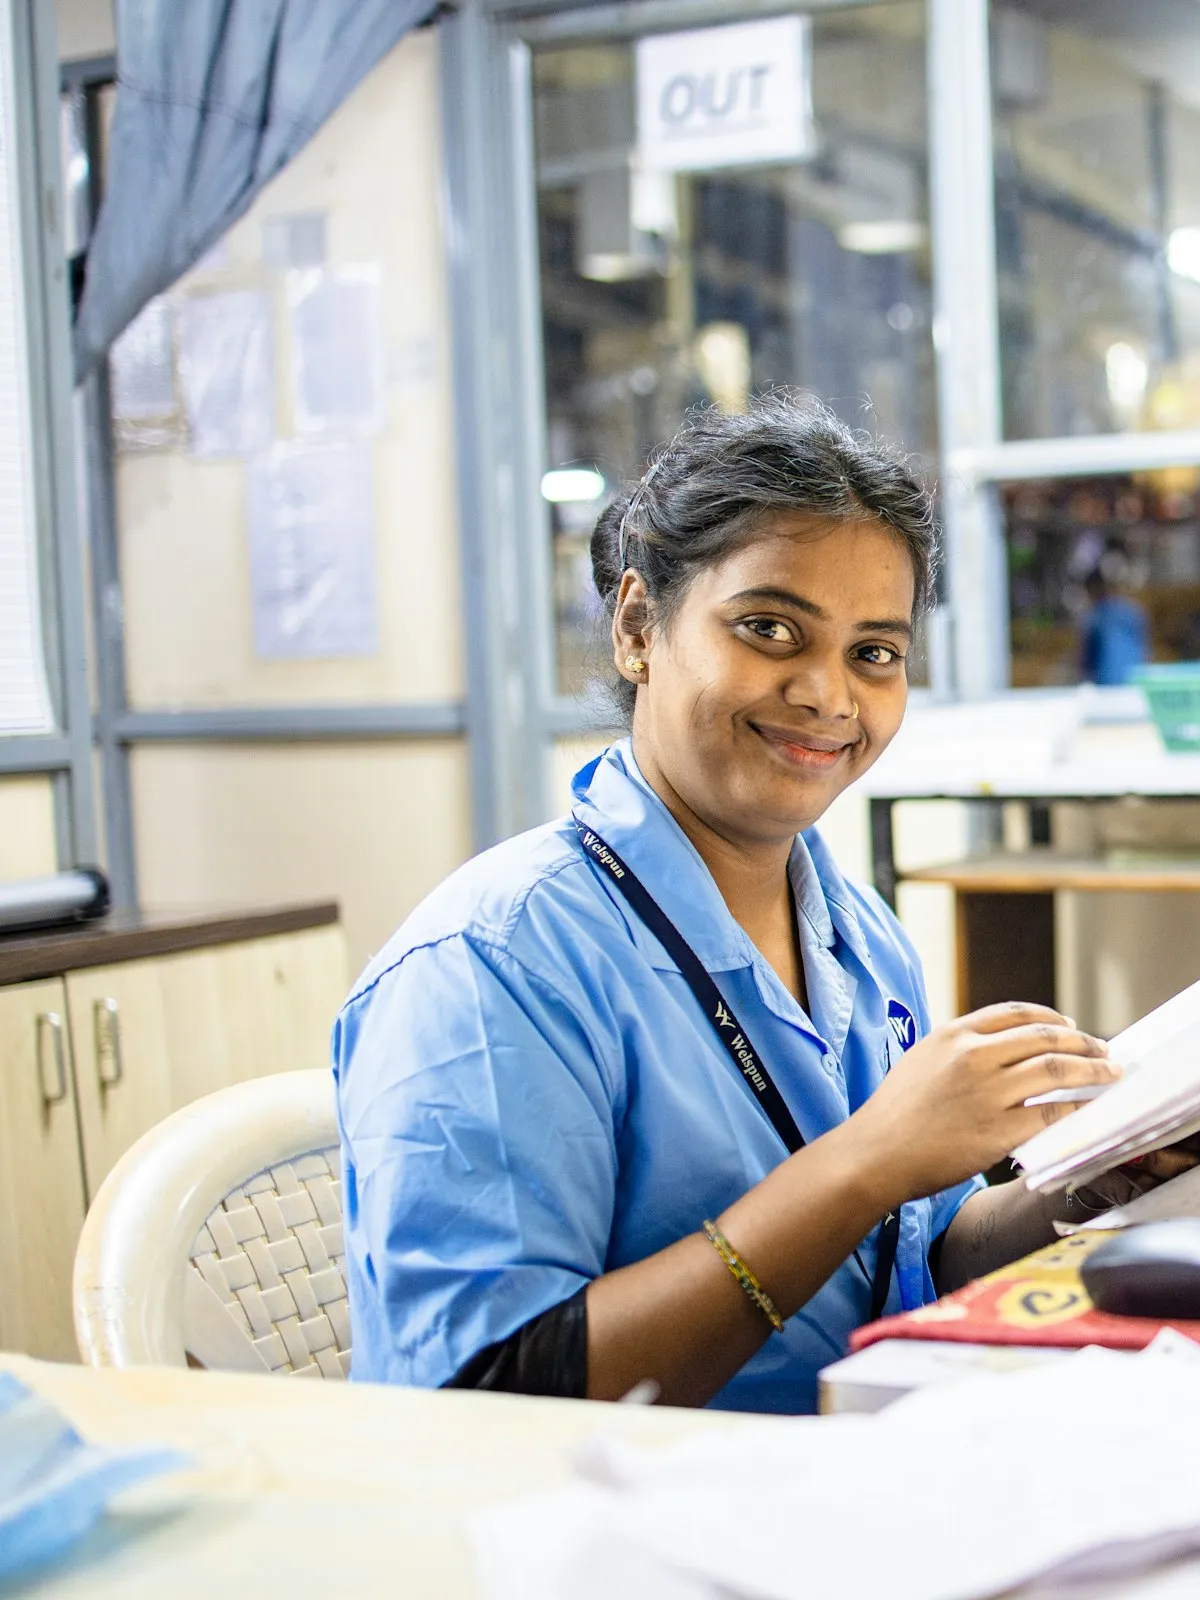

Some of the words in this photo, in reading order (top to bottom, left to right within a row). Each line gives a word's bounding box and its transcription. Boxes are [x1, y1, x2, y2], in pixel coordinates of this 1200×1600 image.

[659, 63, 775, 123] OUT
[583, 831, 626, 879] Welspun
[731, 1033, 768, 1092] Welspun
